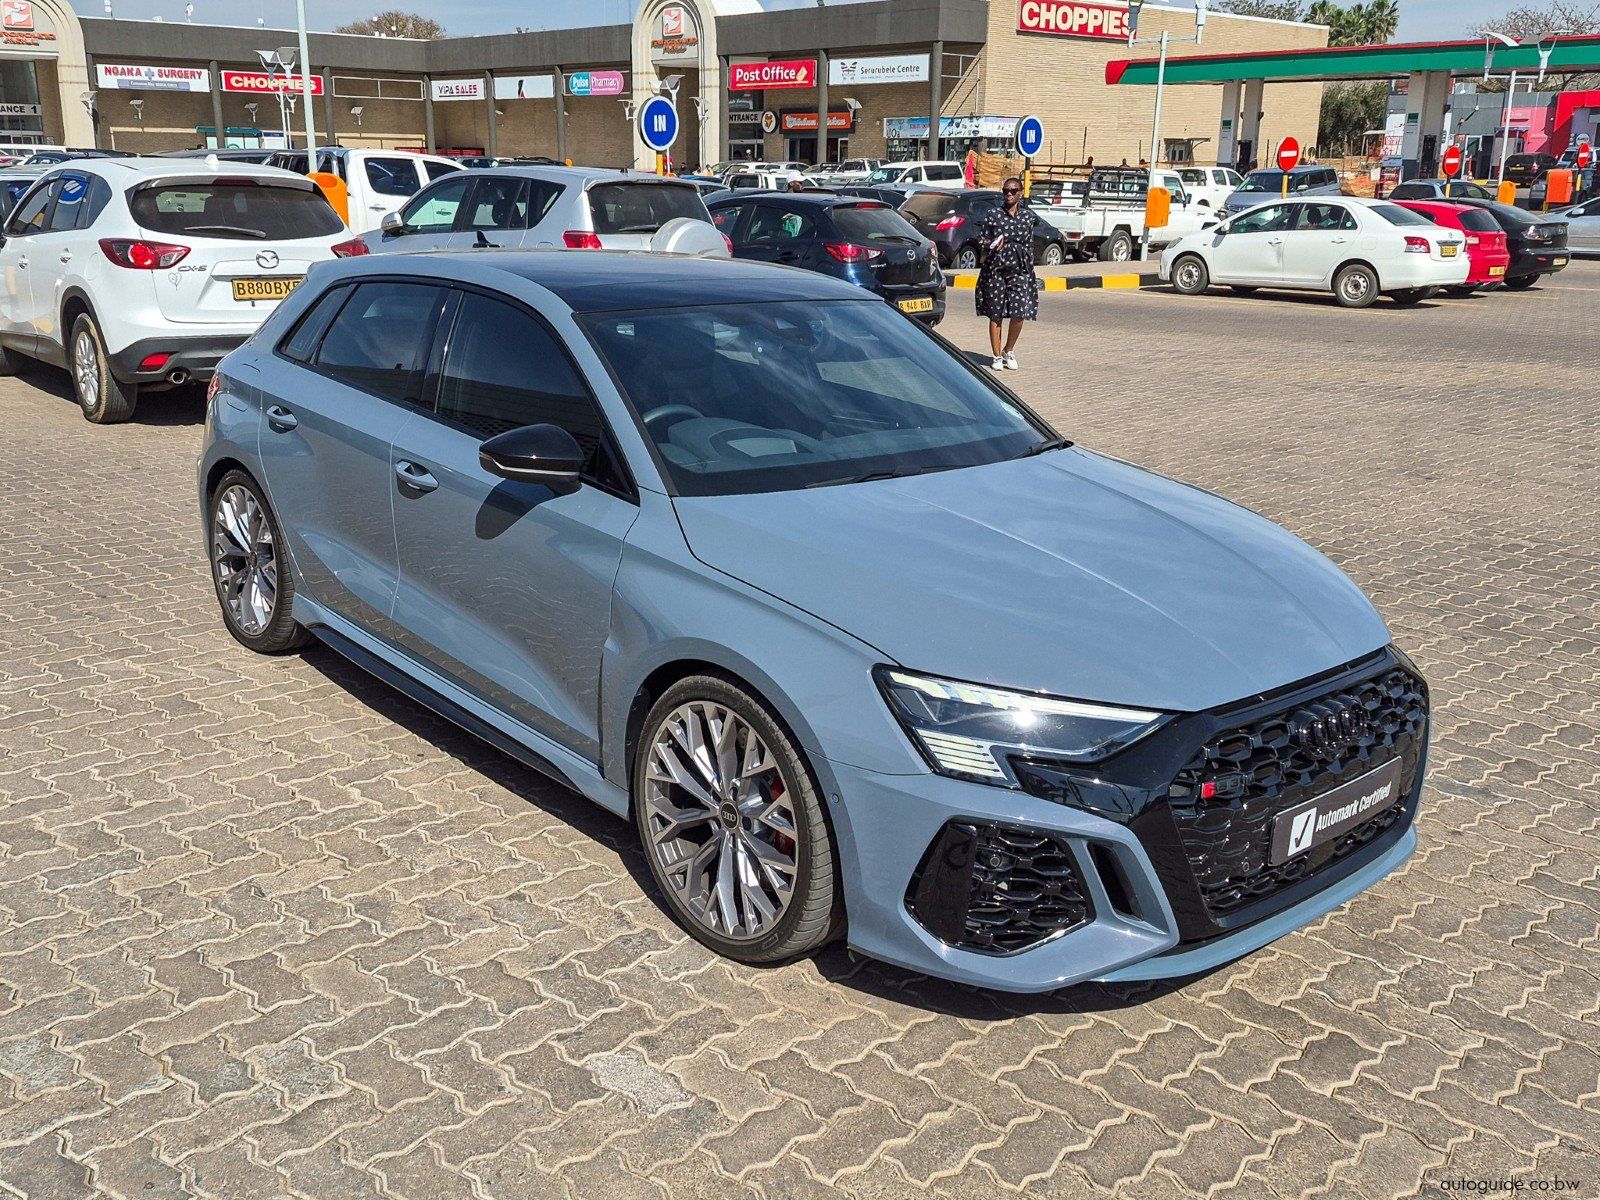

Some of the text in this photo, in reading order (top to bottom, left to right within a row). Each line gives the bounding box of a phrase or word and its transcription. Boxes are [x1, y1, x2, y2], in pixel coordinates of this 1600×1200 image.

[1021, 1, 1131, 36] CHOPPIES
[104, 66, 203, 80] NGAKA SURGERY
[735, 66, 796, 82] Post Office
[860, 65, 920, 75] Serurubele Centre
[438, 84, 478, 95] VIPA SALES
[591, 76, 621, 90] Pharmacy
[30, 105, 38, 114] 1
[653, 114, 667, 132] IN
[728, 113, 759, 122] NTRANCE
[1026, 129, 1036, 144] IN
[1315, 781, 1392, 832] Automark Certified
